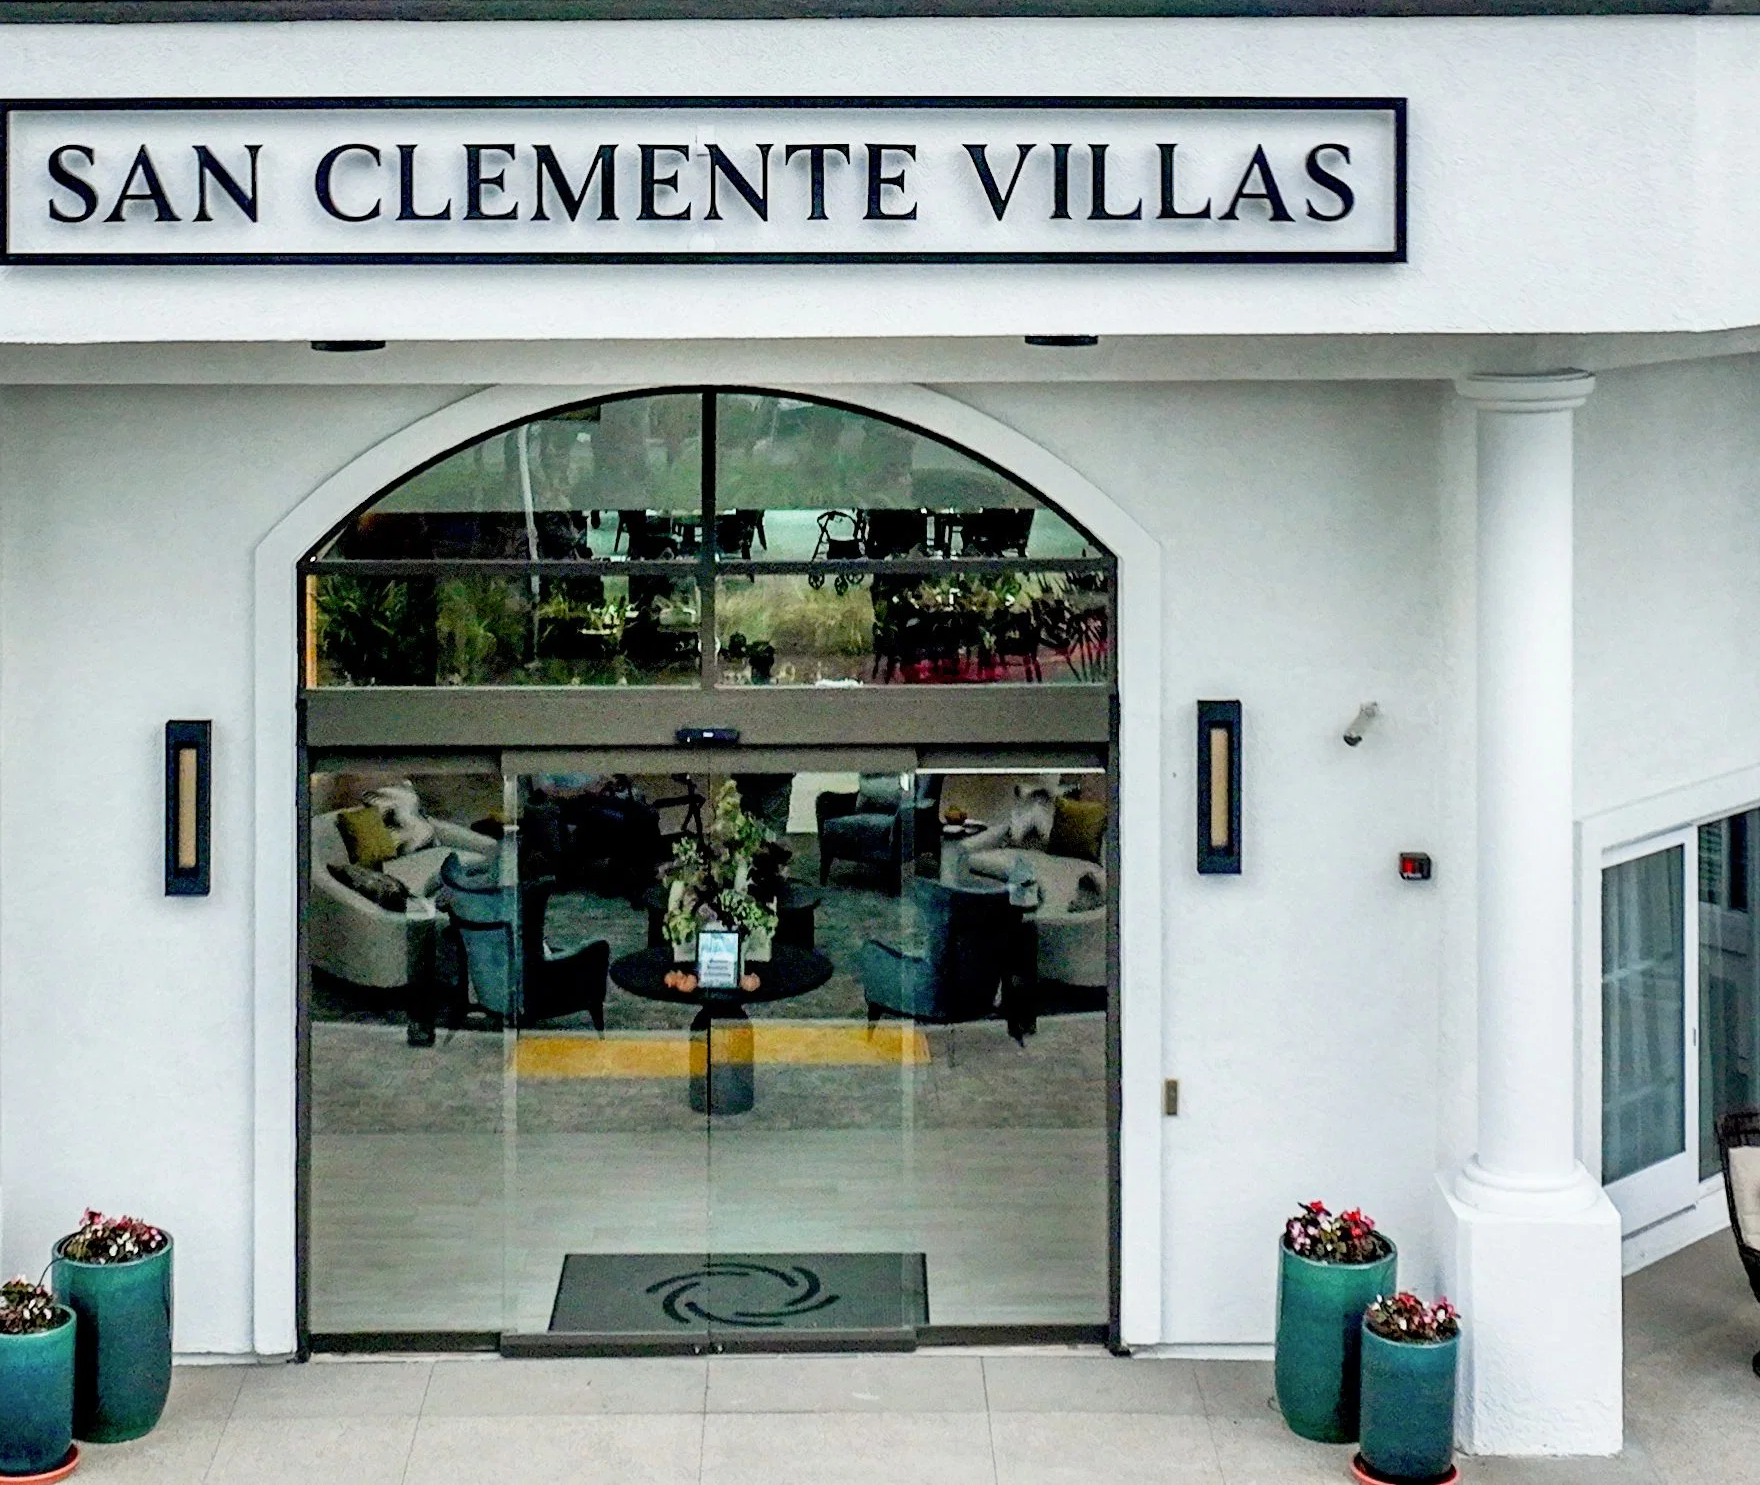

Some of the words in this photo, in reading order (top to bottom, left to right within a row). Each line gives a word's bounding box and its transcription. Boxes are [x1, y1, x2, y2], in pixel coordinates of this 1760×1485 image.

[48, 143, 263, 224] SAN
[314, 143, 918, 223] CLEMENTE
[962, 143, 1355, 223] VILLAS
